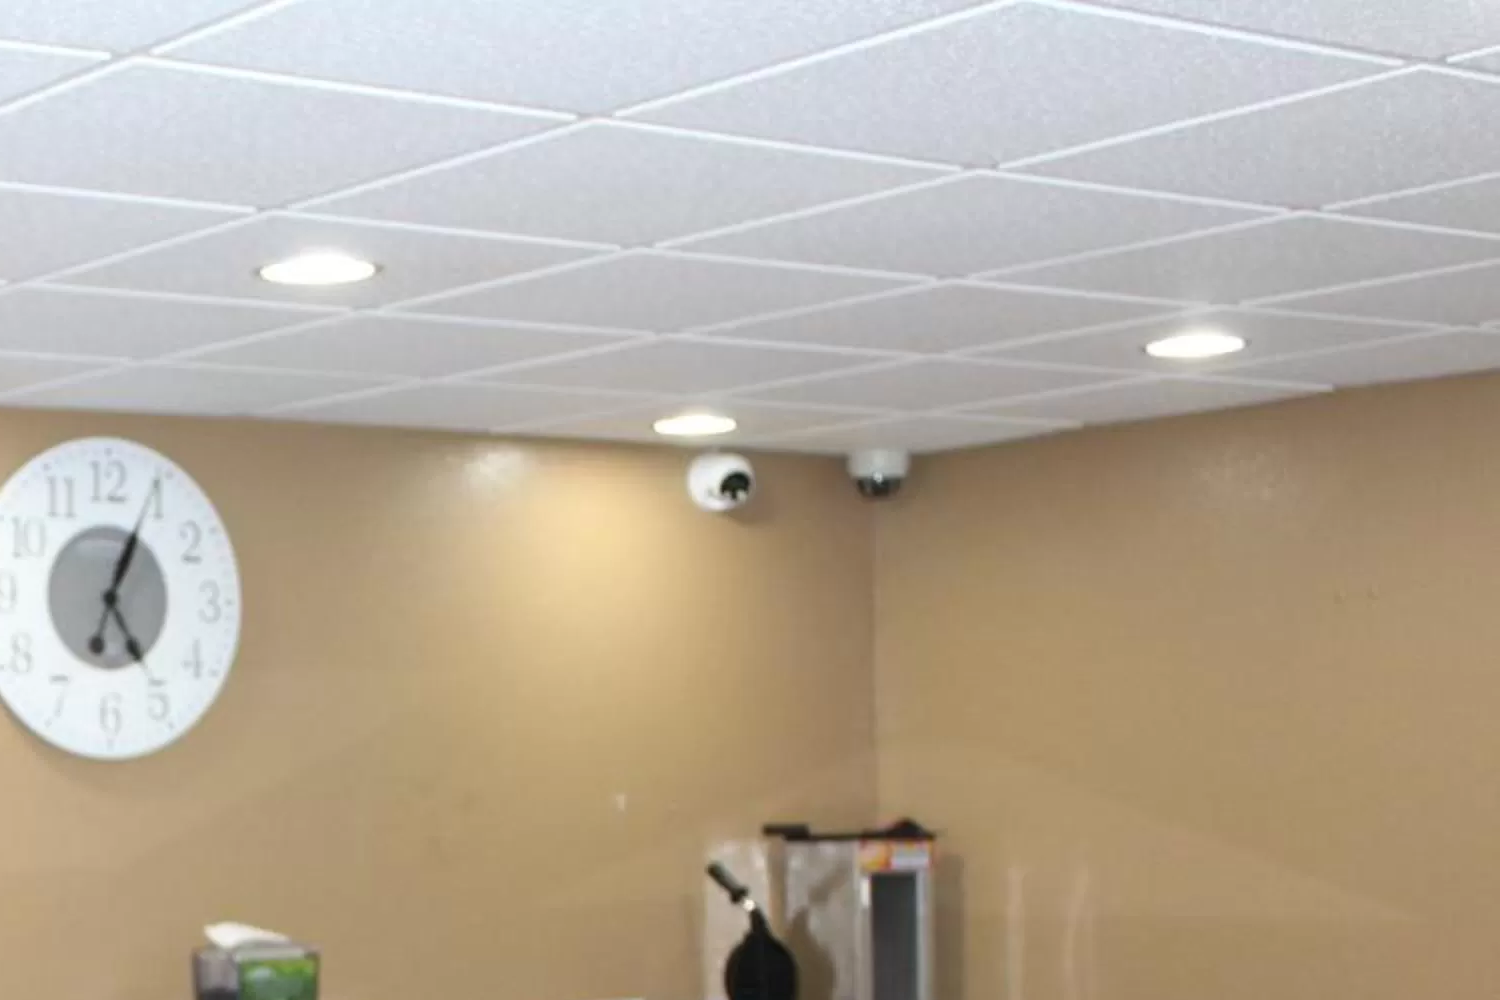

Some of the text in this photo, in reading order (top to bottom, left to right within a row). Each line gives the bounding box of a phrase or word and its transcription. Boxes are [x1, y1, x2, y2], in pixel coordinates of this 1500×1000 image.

[47, 474, 77, 519] 11
[89, 459, 129, 504] 12
[10, 515, 47, 559] 10
[179, 520, 202, 564] 2
[198, 578, 221, 624] 3
[10, 632, 33, 674] 8
[182, 637, 203, 680] 4
[50, 674, 70, 717] 7
[99, 692, 123, 736] 6
[147, 678, 172, 722] 5
